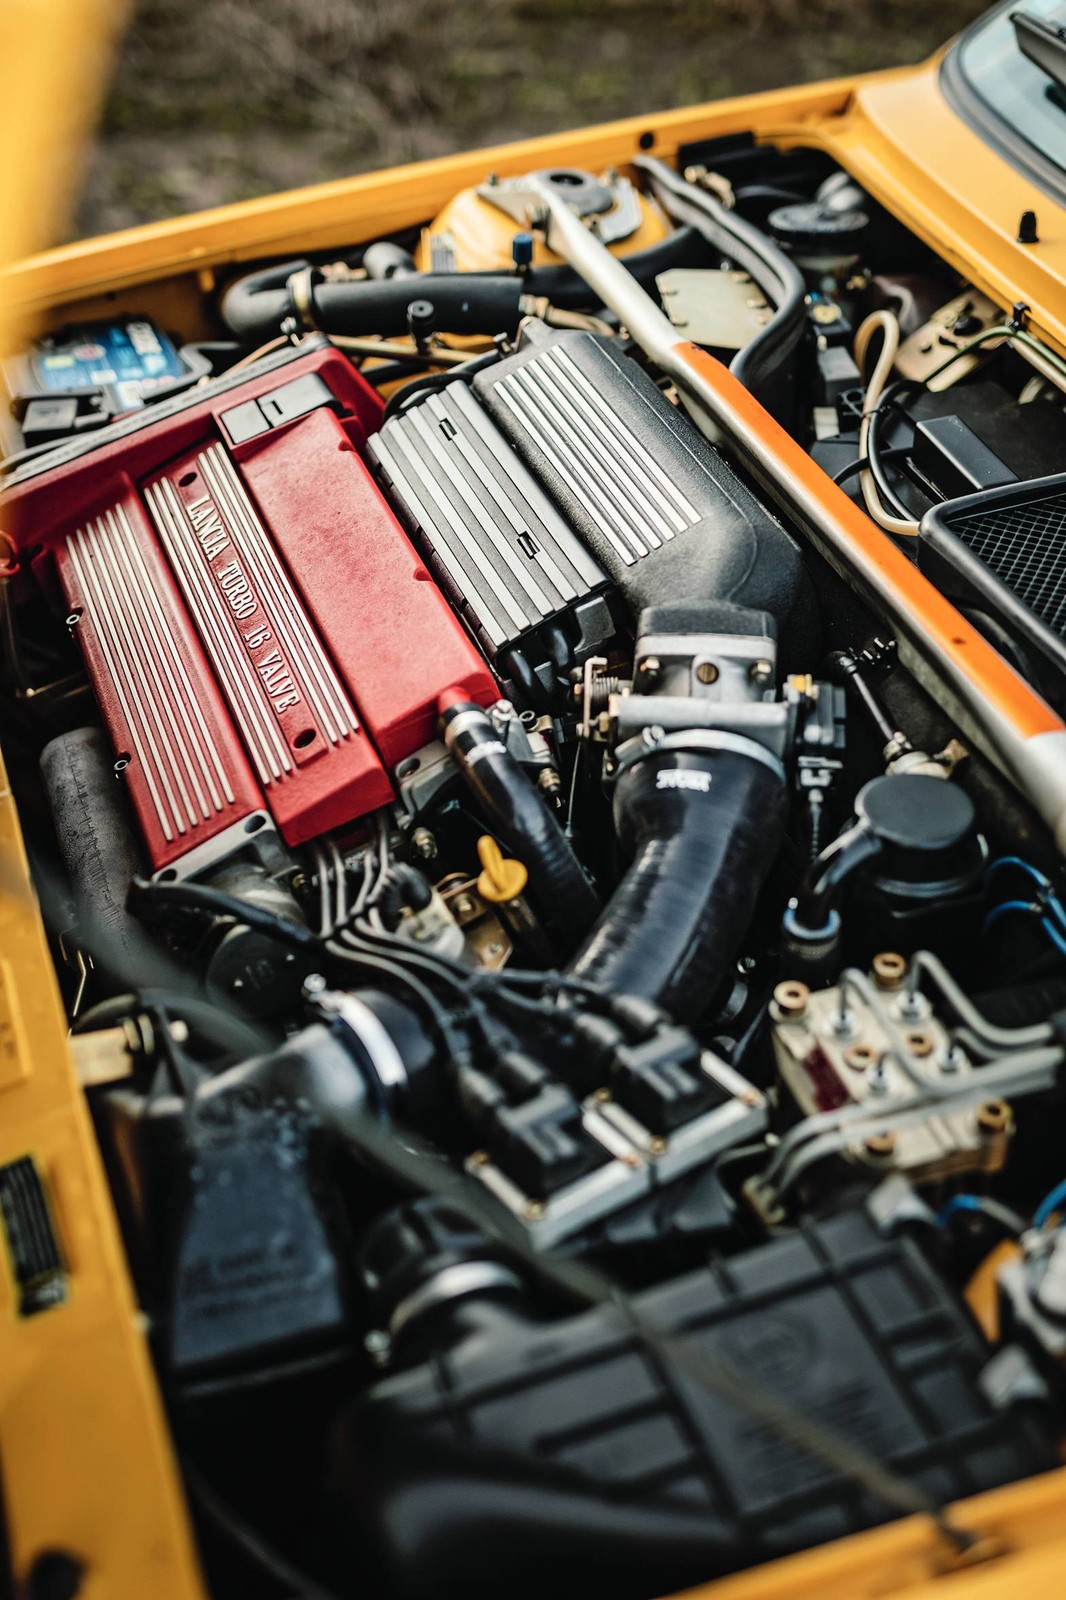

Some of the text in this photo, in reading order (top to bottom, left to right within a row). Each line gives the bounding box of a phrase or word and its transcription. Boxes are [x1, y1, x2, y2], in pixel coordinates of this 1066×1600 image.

[187, 495, 300, 714] LANCIA TURBO 16 VALVE
